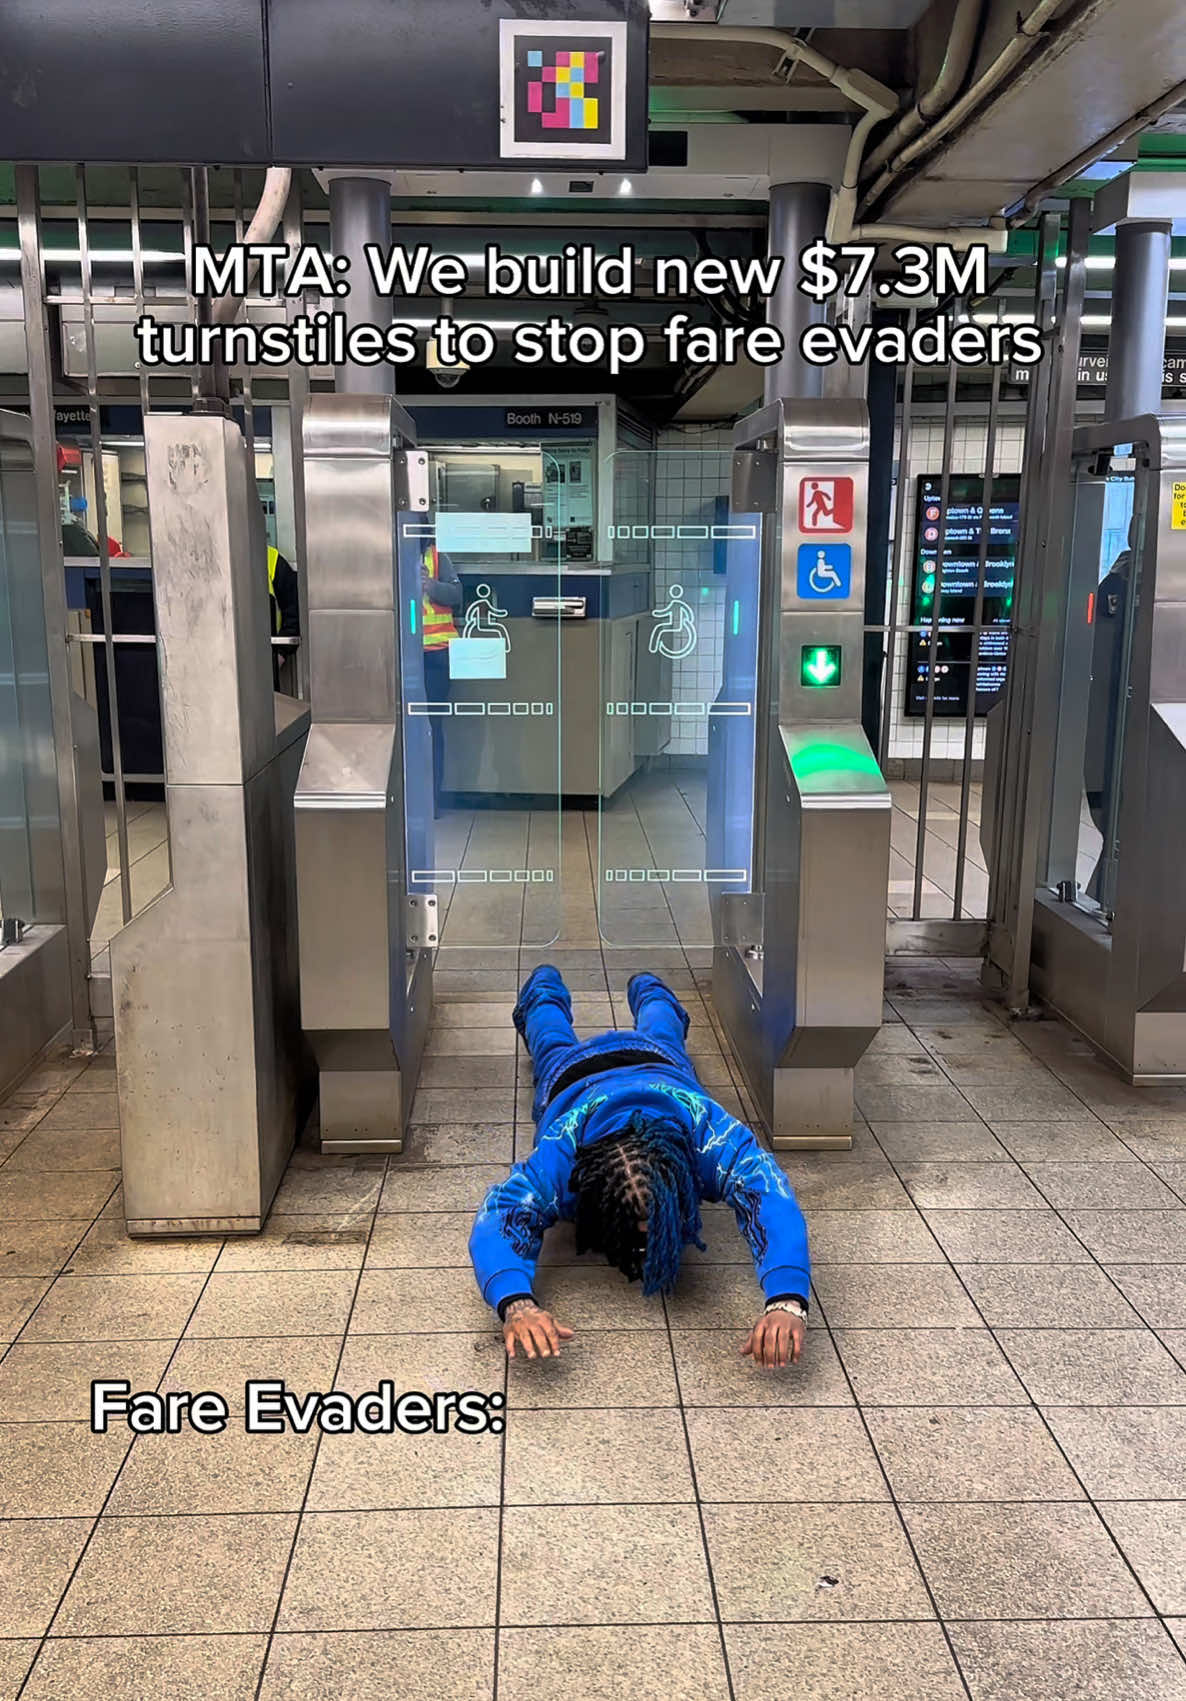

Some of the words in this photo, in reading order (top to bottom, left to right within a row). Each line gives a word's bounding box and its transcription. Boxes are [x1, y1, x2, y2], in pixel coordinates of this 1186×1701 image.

[507, 412, 541, 425] Booth
[548, 412, 583, 425] N-519
[946, 508, 969, 516] ptown
[945, 528, 967, 536] ptown
